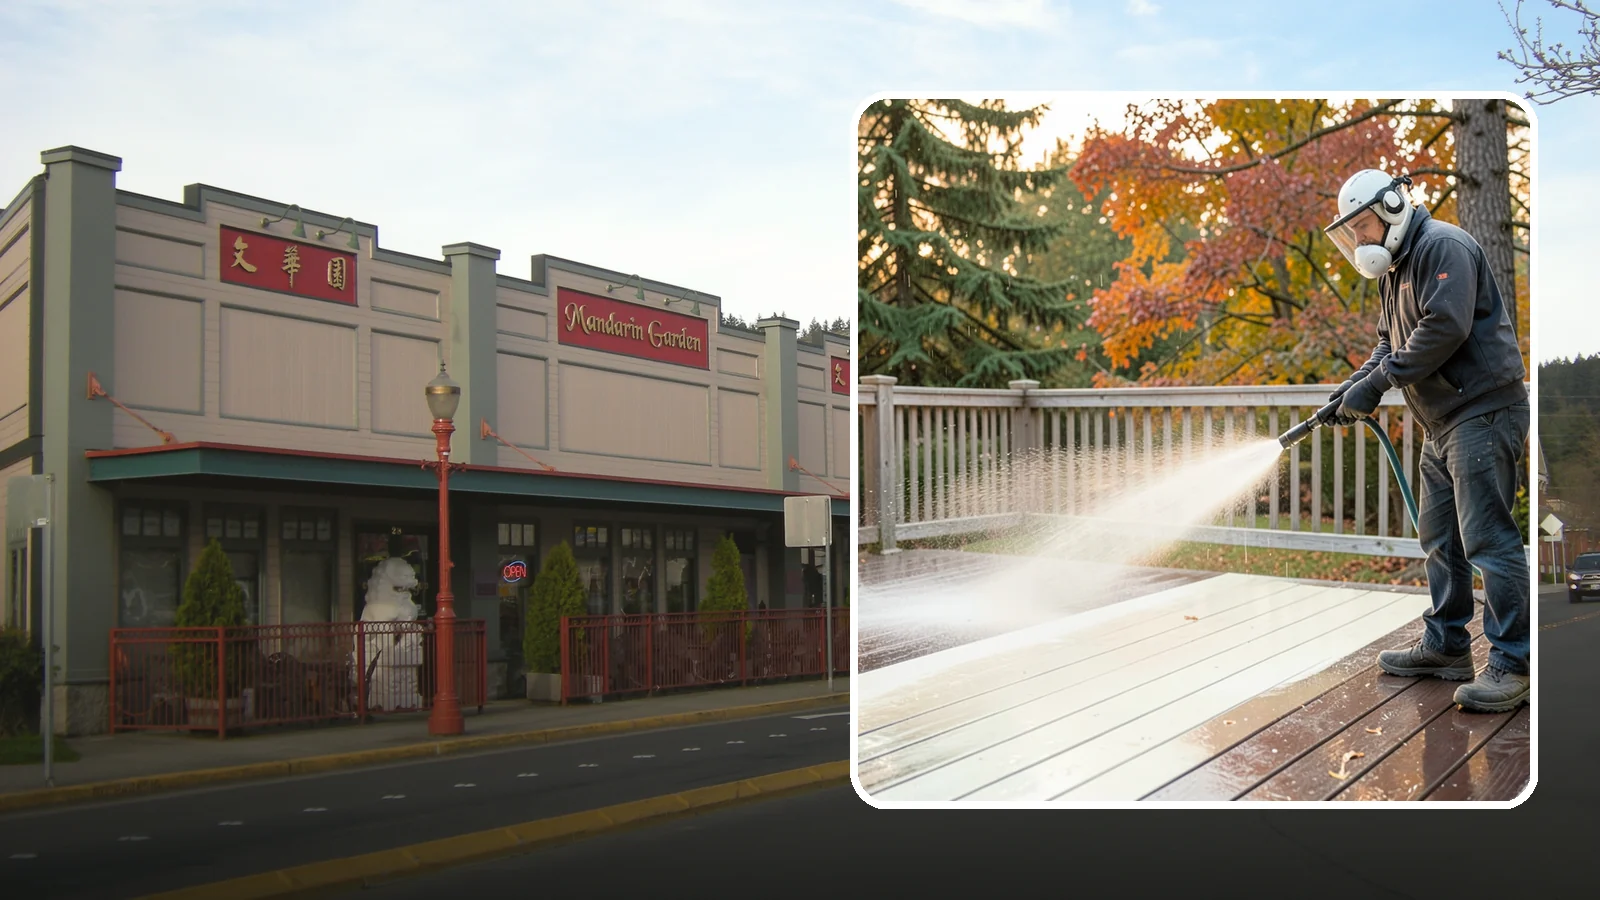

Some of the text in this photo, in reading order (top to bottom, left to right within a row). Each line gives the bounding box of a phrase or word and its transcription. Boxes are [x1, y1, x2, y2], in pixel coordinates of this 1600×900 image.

[231, 235, 346, 291] 文華園
[564, 302, 702, 352] Mandarin Garden
[503, 565, 527, 578] OPEN
